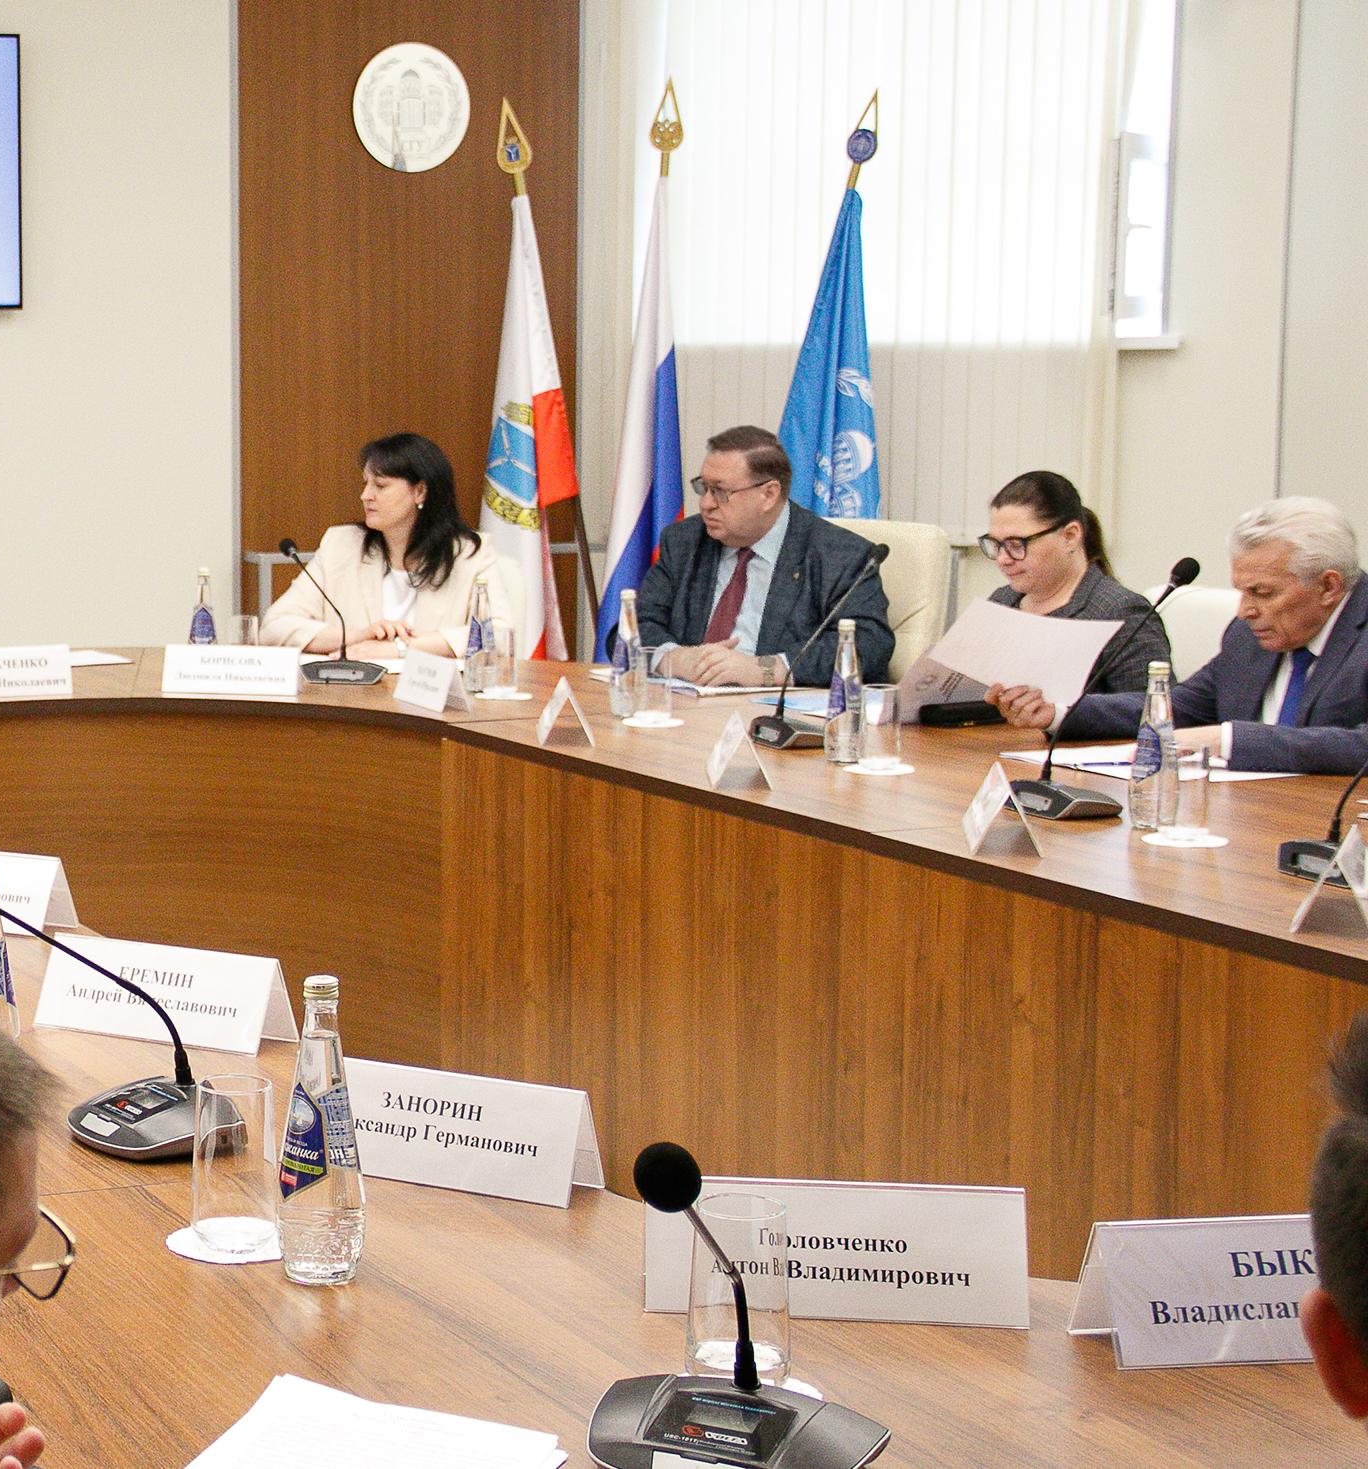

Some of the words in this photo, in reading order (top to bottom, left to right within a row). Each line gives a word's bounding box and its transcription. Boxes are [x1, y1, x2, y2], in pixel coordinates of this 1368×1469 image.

[119, 965, 195, 989] ЕРЕМИН
[66, 984, 122, 1004] Андрей
[381, 1091, 484, 1122] ЗАНОРИН
[423, 1124, 539, 1157] Германович
[786, 1259, 972, 1289] Владимирович
[1228, 1248, 1317, 1278] БЫК
